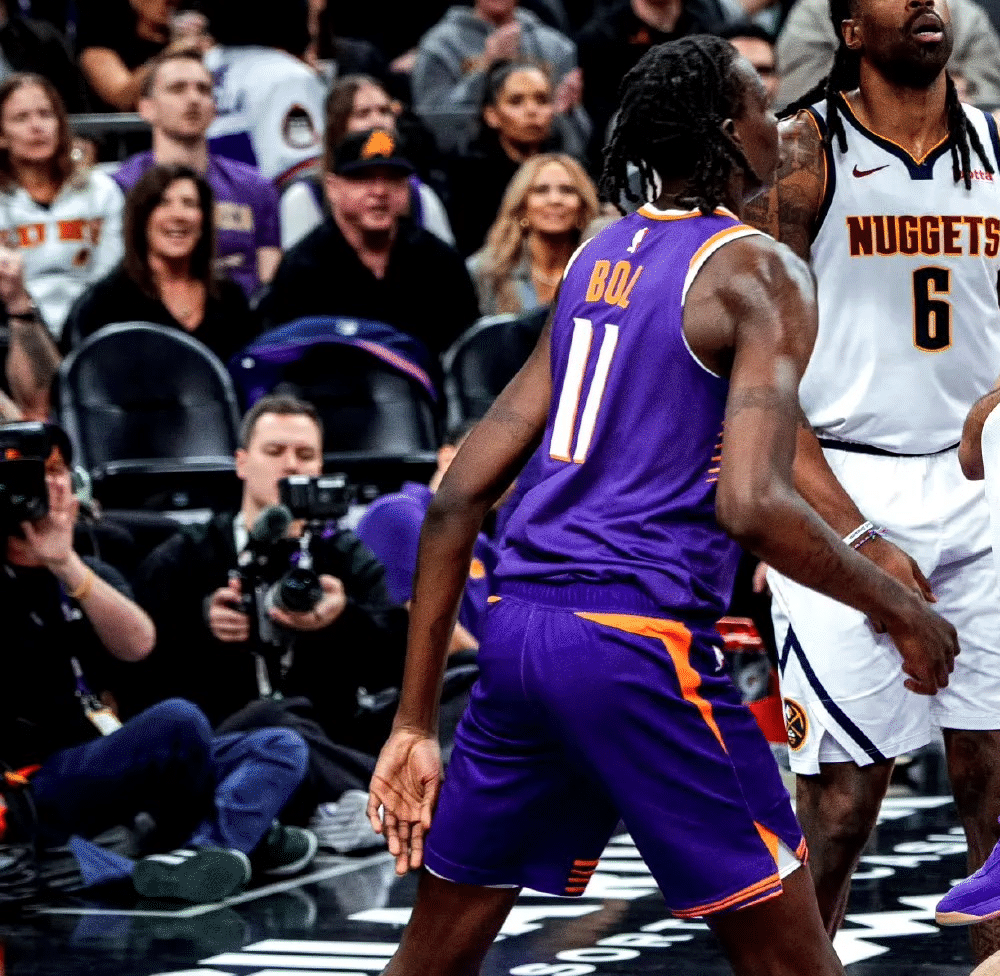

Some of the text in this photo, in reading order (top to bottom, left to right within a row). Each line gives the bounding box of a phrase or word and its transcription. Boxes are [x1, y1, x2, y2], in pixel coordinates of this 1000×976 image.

[846, 215, 1000, 258] NUGGETS
[585, 259, 644, 309] BOL
[912, 264, 953, 353] 6
[549, 316, 620, 465] 11
